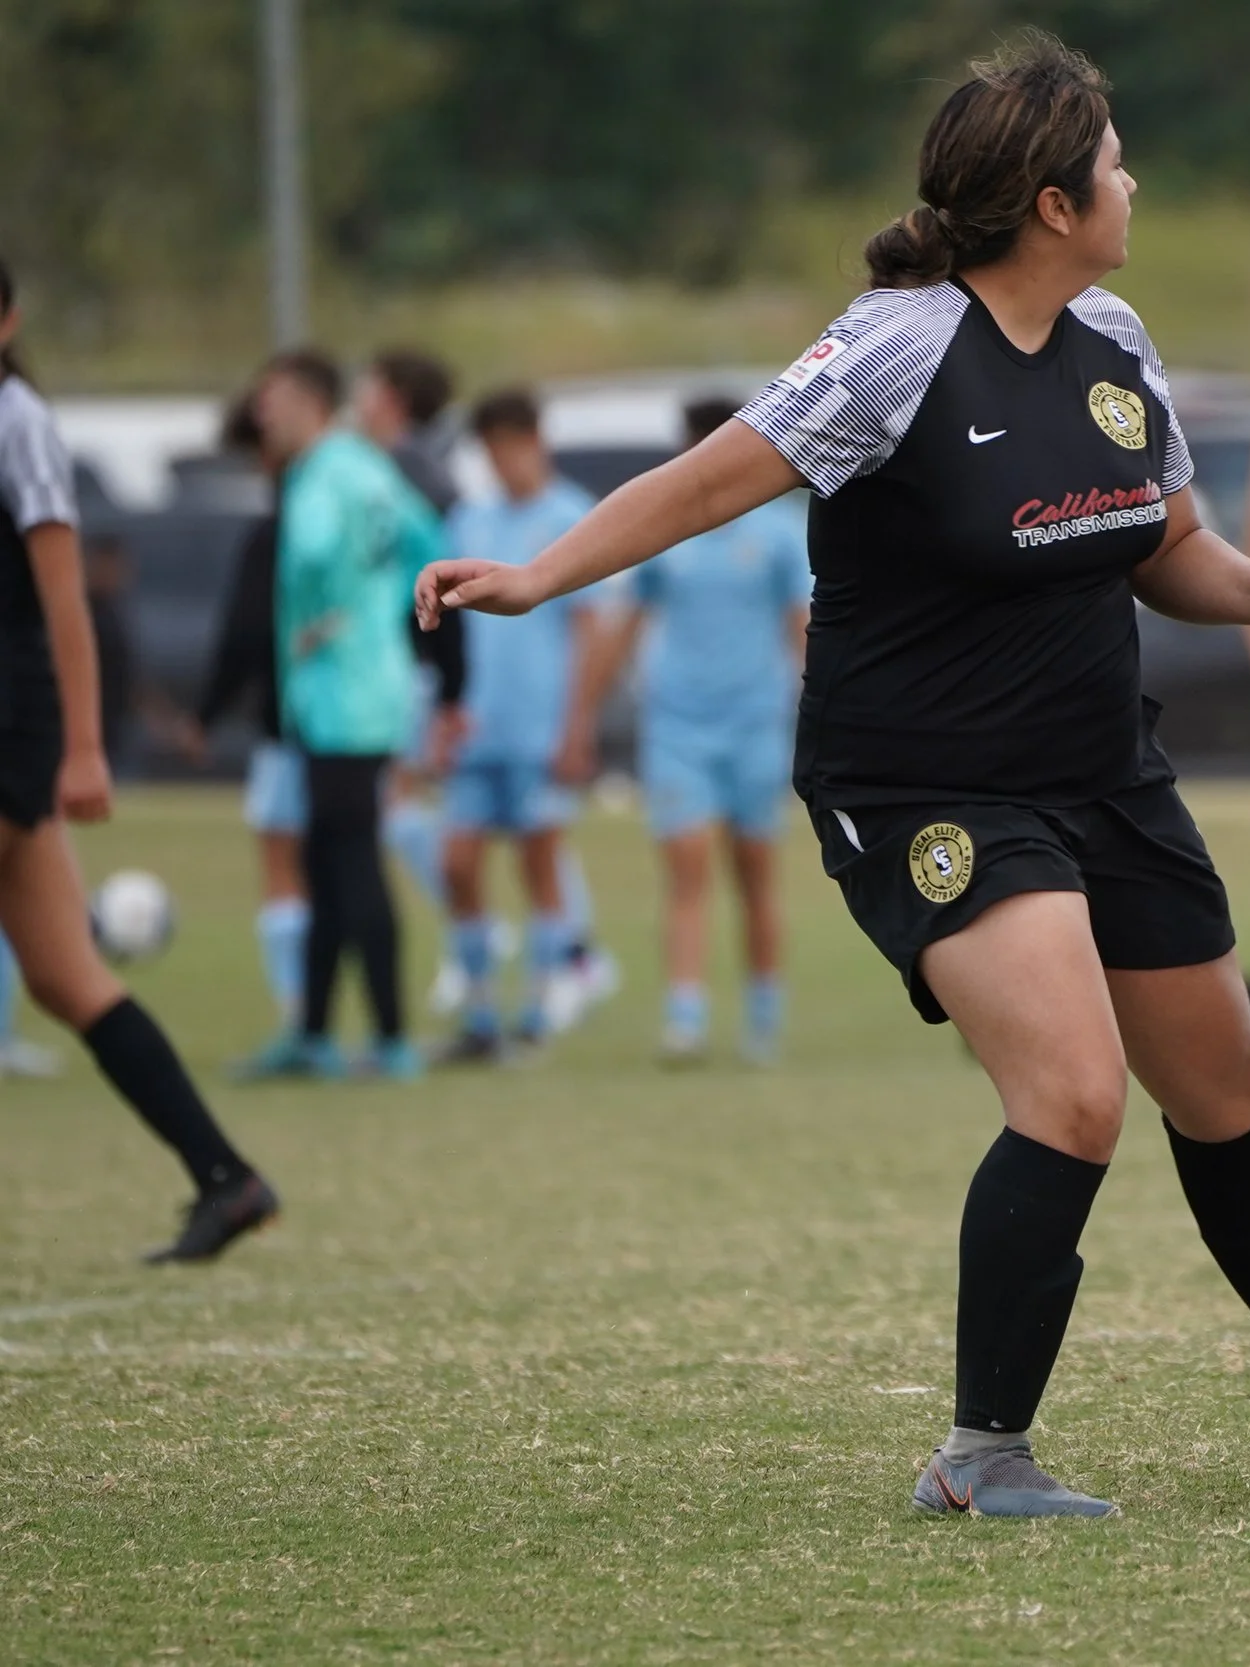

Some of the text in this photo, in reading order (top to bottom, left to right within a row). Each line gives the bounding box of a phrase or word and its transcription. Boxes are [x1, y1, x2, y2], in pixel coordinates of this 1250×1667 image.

[1012, 478, 1161, 529] California
[912, 826, 961, 861] SOCAL ELITE
[920, 881, 961, 901] FOOTBALL
[960, 856, 971, 884] CLUB
